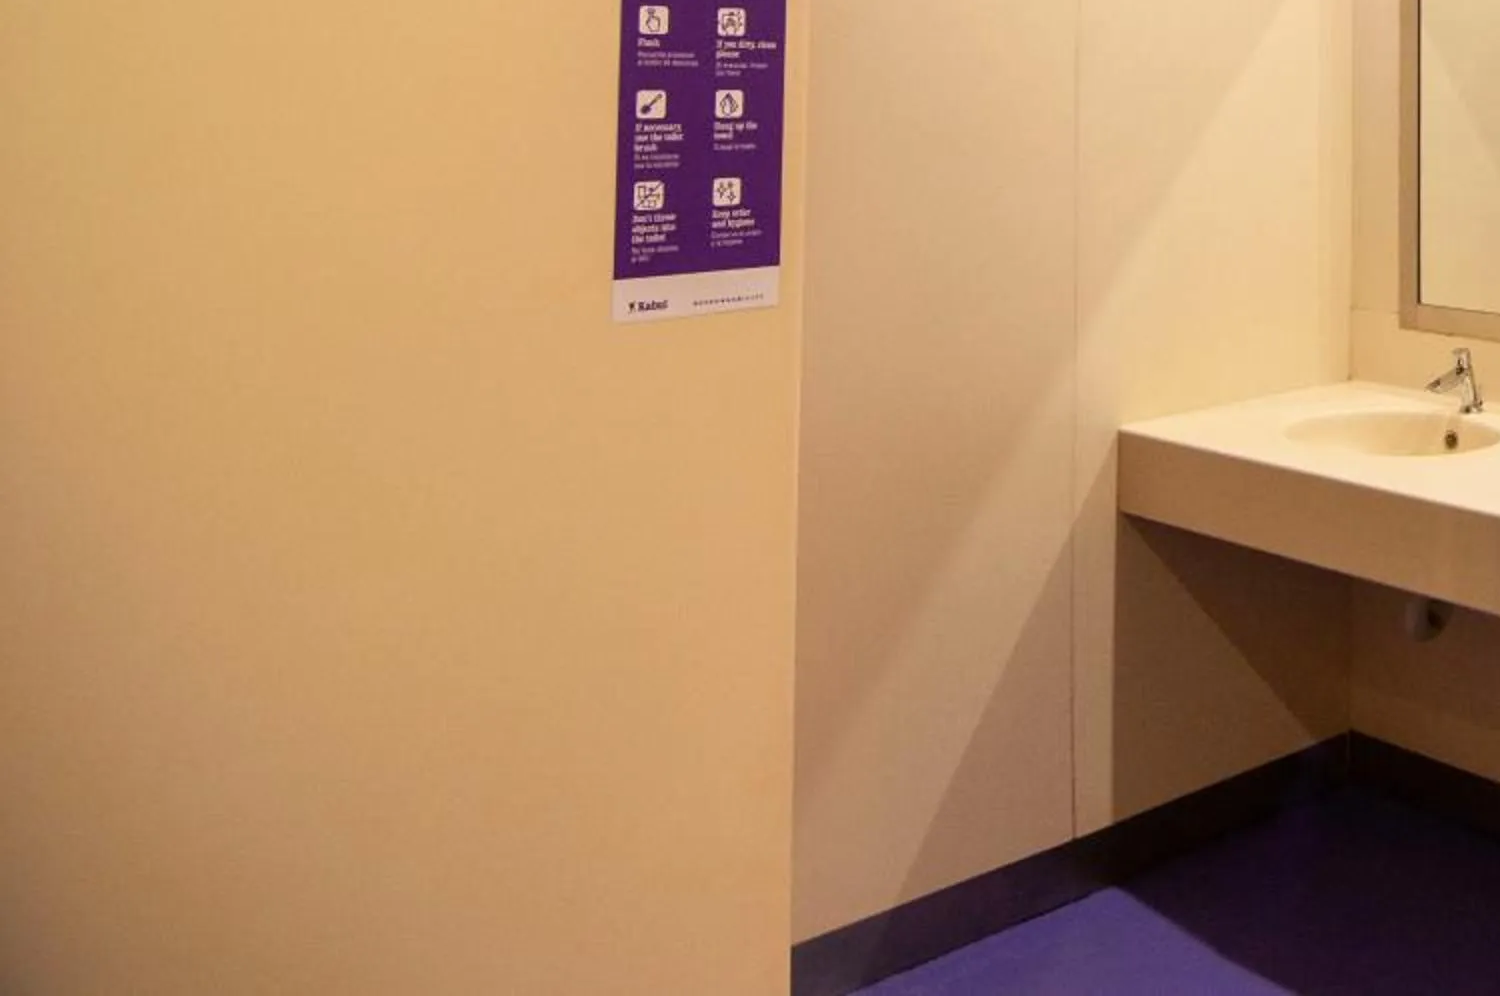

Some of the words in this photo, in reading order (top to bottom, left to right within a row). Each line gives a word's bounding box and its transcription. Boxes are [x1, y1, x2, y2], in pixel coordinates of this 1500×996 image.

[637, 37, 661, 48] Flush
[723, 41, 737, 51] you
[635, 123, 643, 132] If
[714, 121, 734, 133] Hang
[735, 122, 745, 132] up
[746, 120, 758, 130] the
[634, 134, 649, 142] use
[649, 133, 663, 142] the
[663, 132, 684, 141] toilet
[712, 209, 731, 220] Keep
[732, 208, 751, 217] order
[712, 219, 726, 229] and
[631, 234, 645, 245] the
[645, 233, 667, 243] toilet
[637, 300, 669, 312] Kabul
